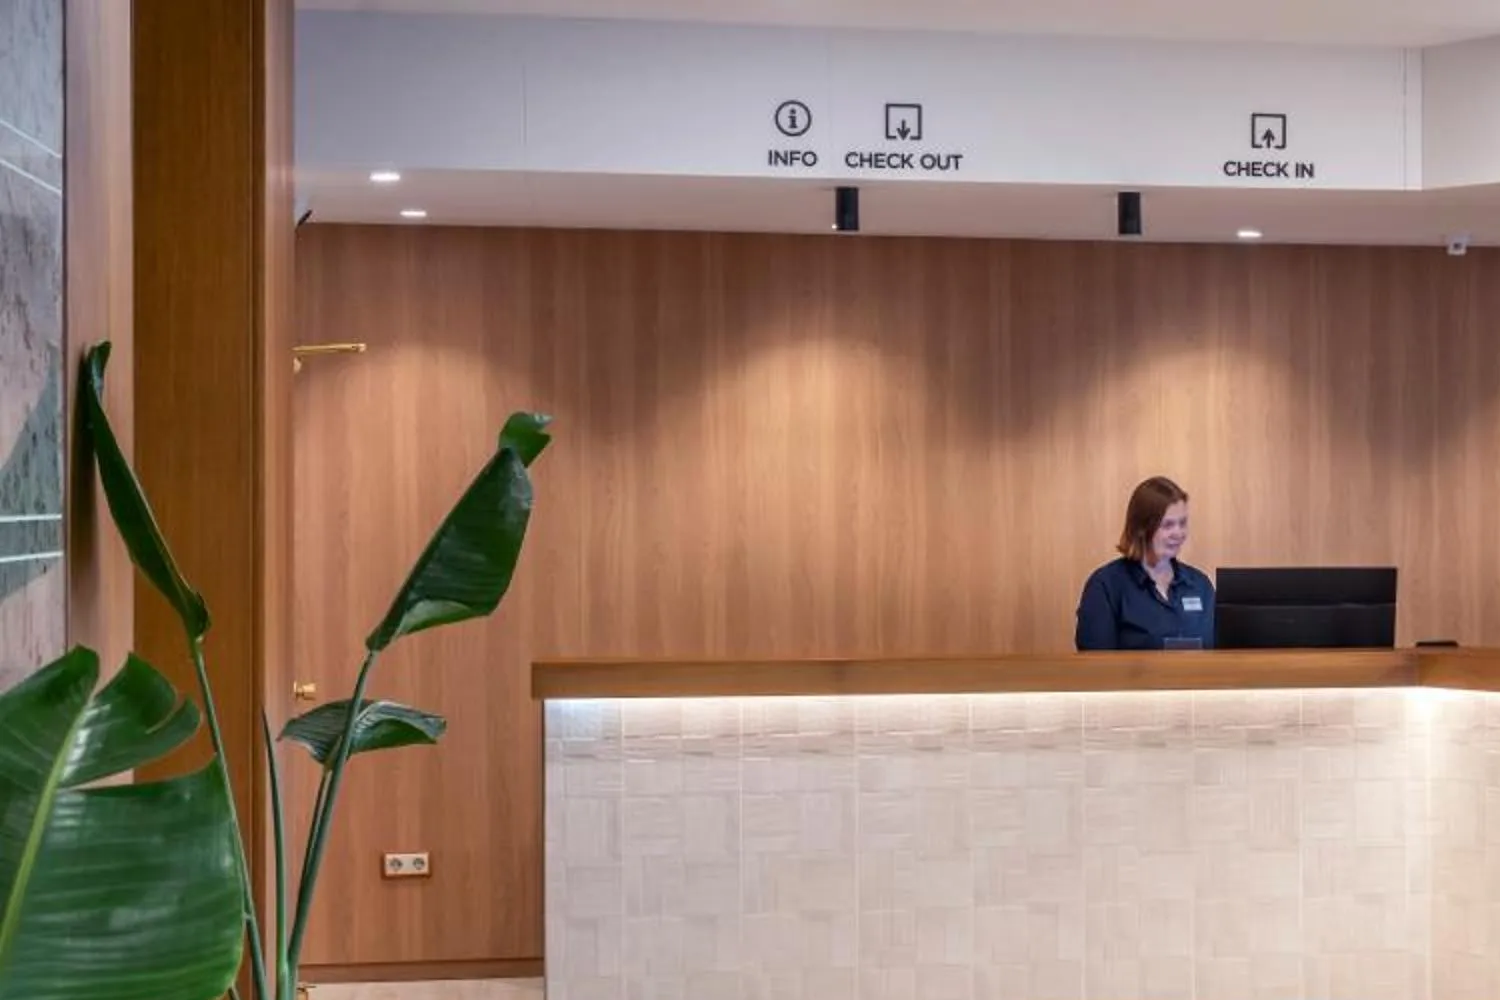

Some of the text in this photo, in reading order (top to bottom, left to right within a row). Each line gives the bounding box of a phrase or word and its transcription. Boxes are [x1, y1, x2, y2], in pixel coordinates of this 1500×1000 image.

[767, 149, 818, 168] INFO
[844, 151, 964, 171] CHECK OUT
[1223, 160, 1315, 179] CHECK IN
